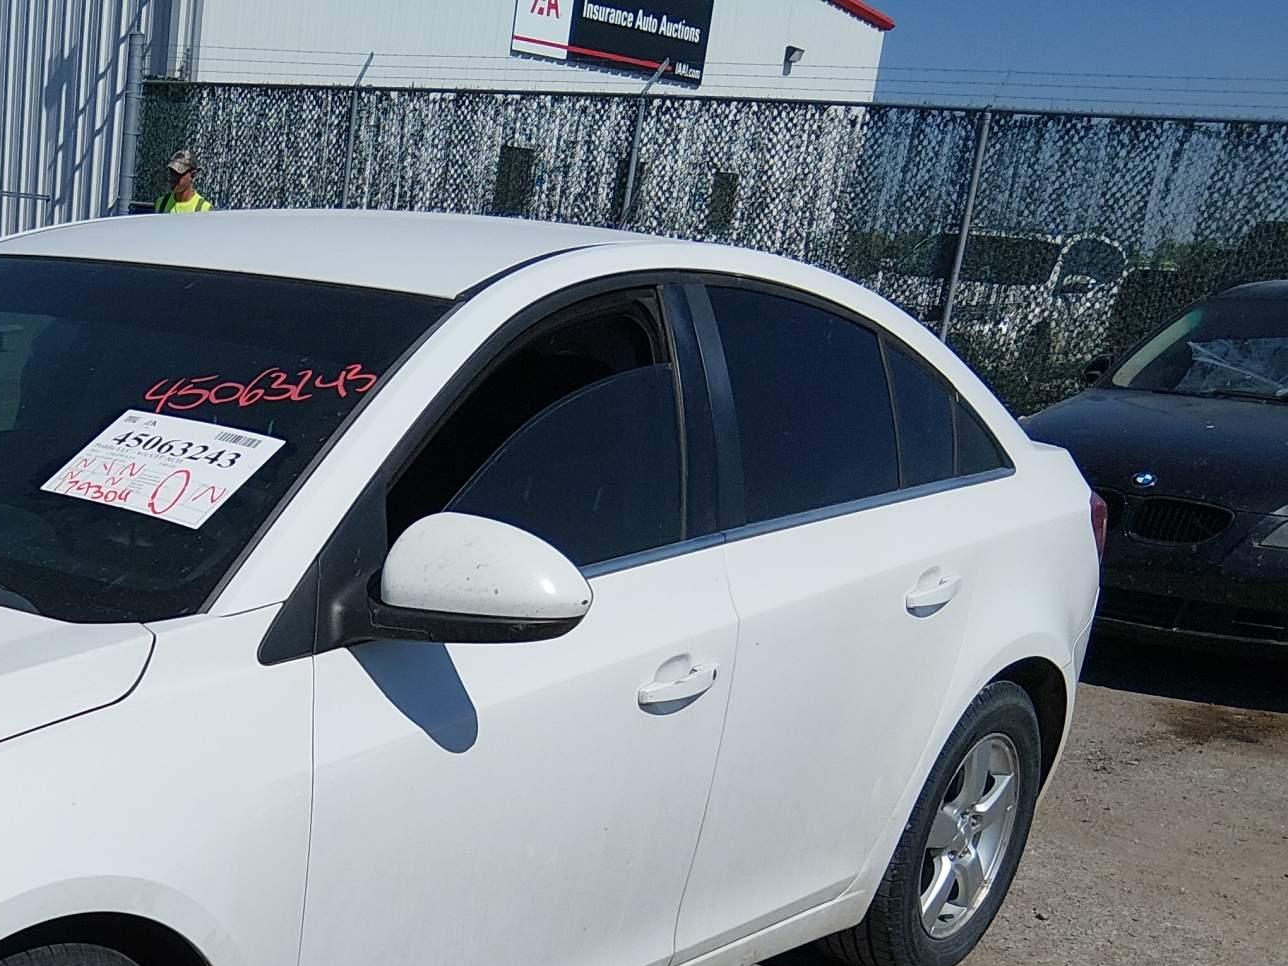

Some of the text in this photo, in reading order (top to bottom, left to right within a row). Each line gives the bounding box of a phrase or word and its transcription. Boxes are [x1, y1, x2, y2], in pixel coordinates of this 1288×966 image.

[583, 0, 701, 43] Insurance Auto Auctions
[145, 364, 377, 413] 45063243
[113, 431, 242, 468] 45063243
